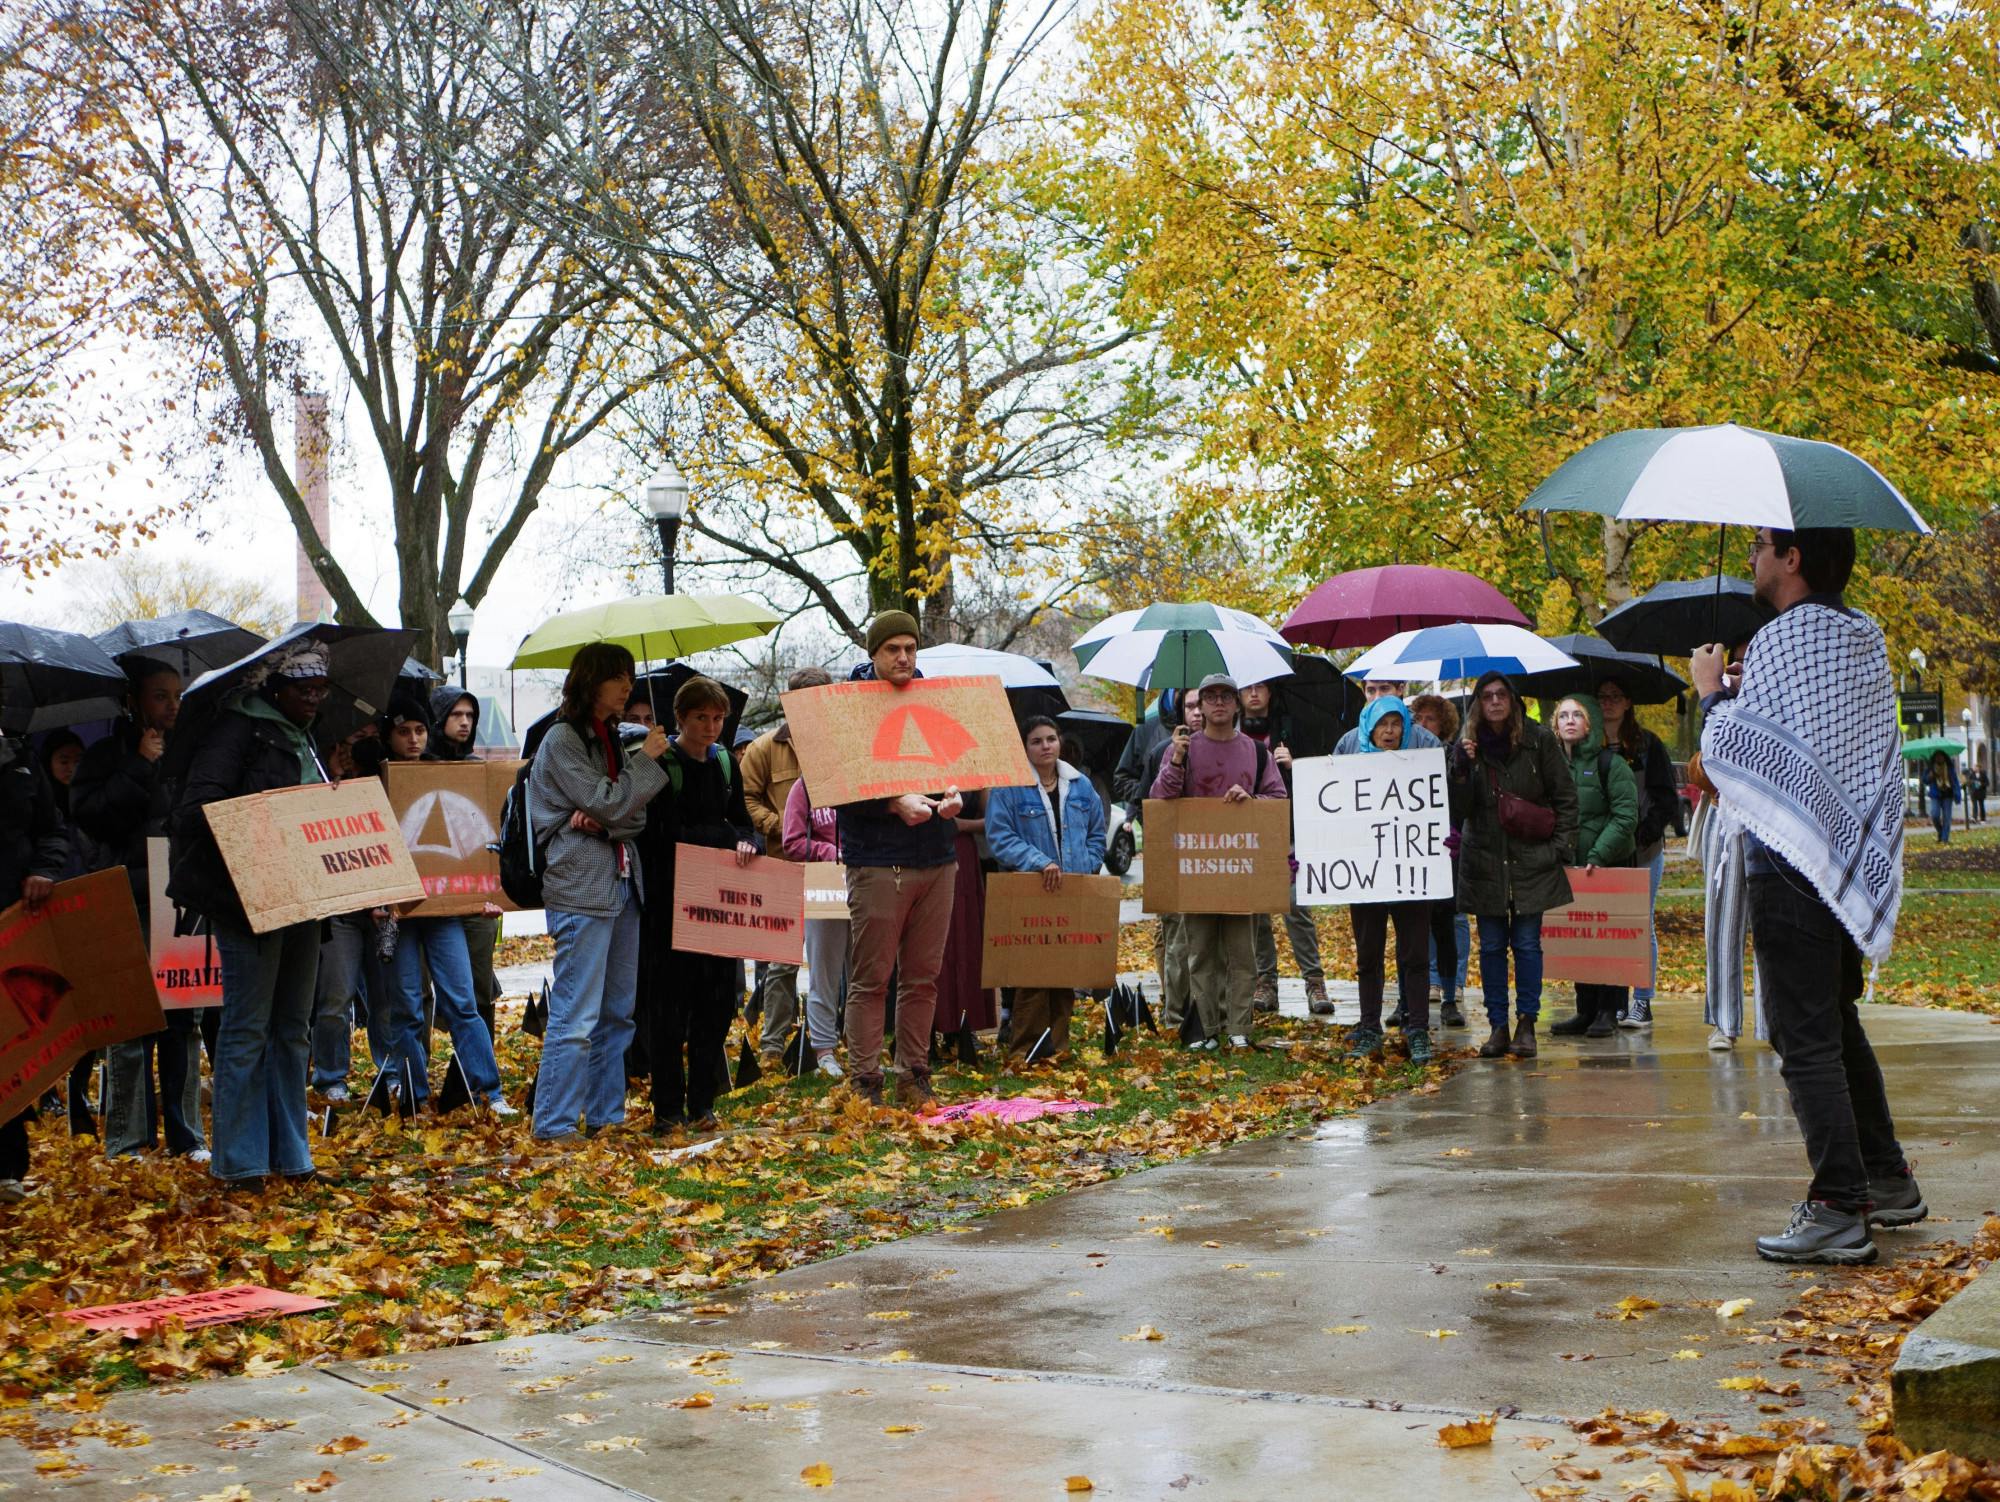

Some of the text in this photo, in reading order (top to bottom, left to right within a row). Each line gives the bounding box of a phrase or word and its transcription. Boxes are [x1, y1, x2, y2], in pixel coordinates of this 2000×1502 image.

[1318, 774, 1444, 813] CEASE
[301, 811, 386, 844] BEILOCK
[1371, 816, 1441, 858] FIRE
[1174, 832, 1260, 850] BEILOCK
[321, 843, 393, 875] RESIGN
[1179, 857, 1254, 875] RESIGN
[1307, 859, 1428, 896] NOW !!!
[719, 889, 763, 908] THIS IS
[682, 905, 795, 932] “PHYSICAL ACTION”
[1021, 914, 1070, 928] THIS IS
[1567, 911, 1608, 922] THIS IS
[1595, 927, 1643, 939] ACTION”
